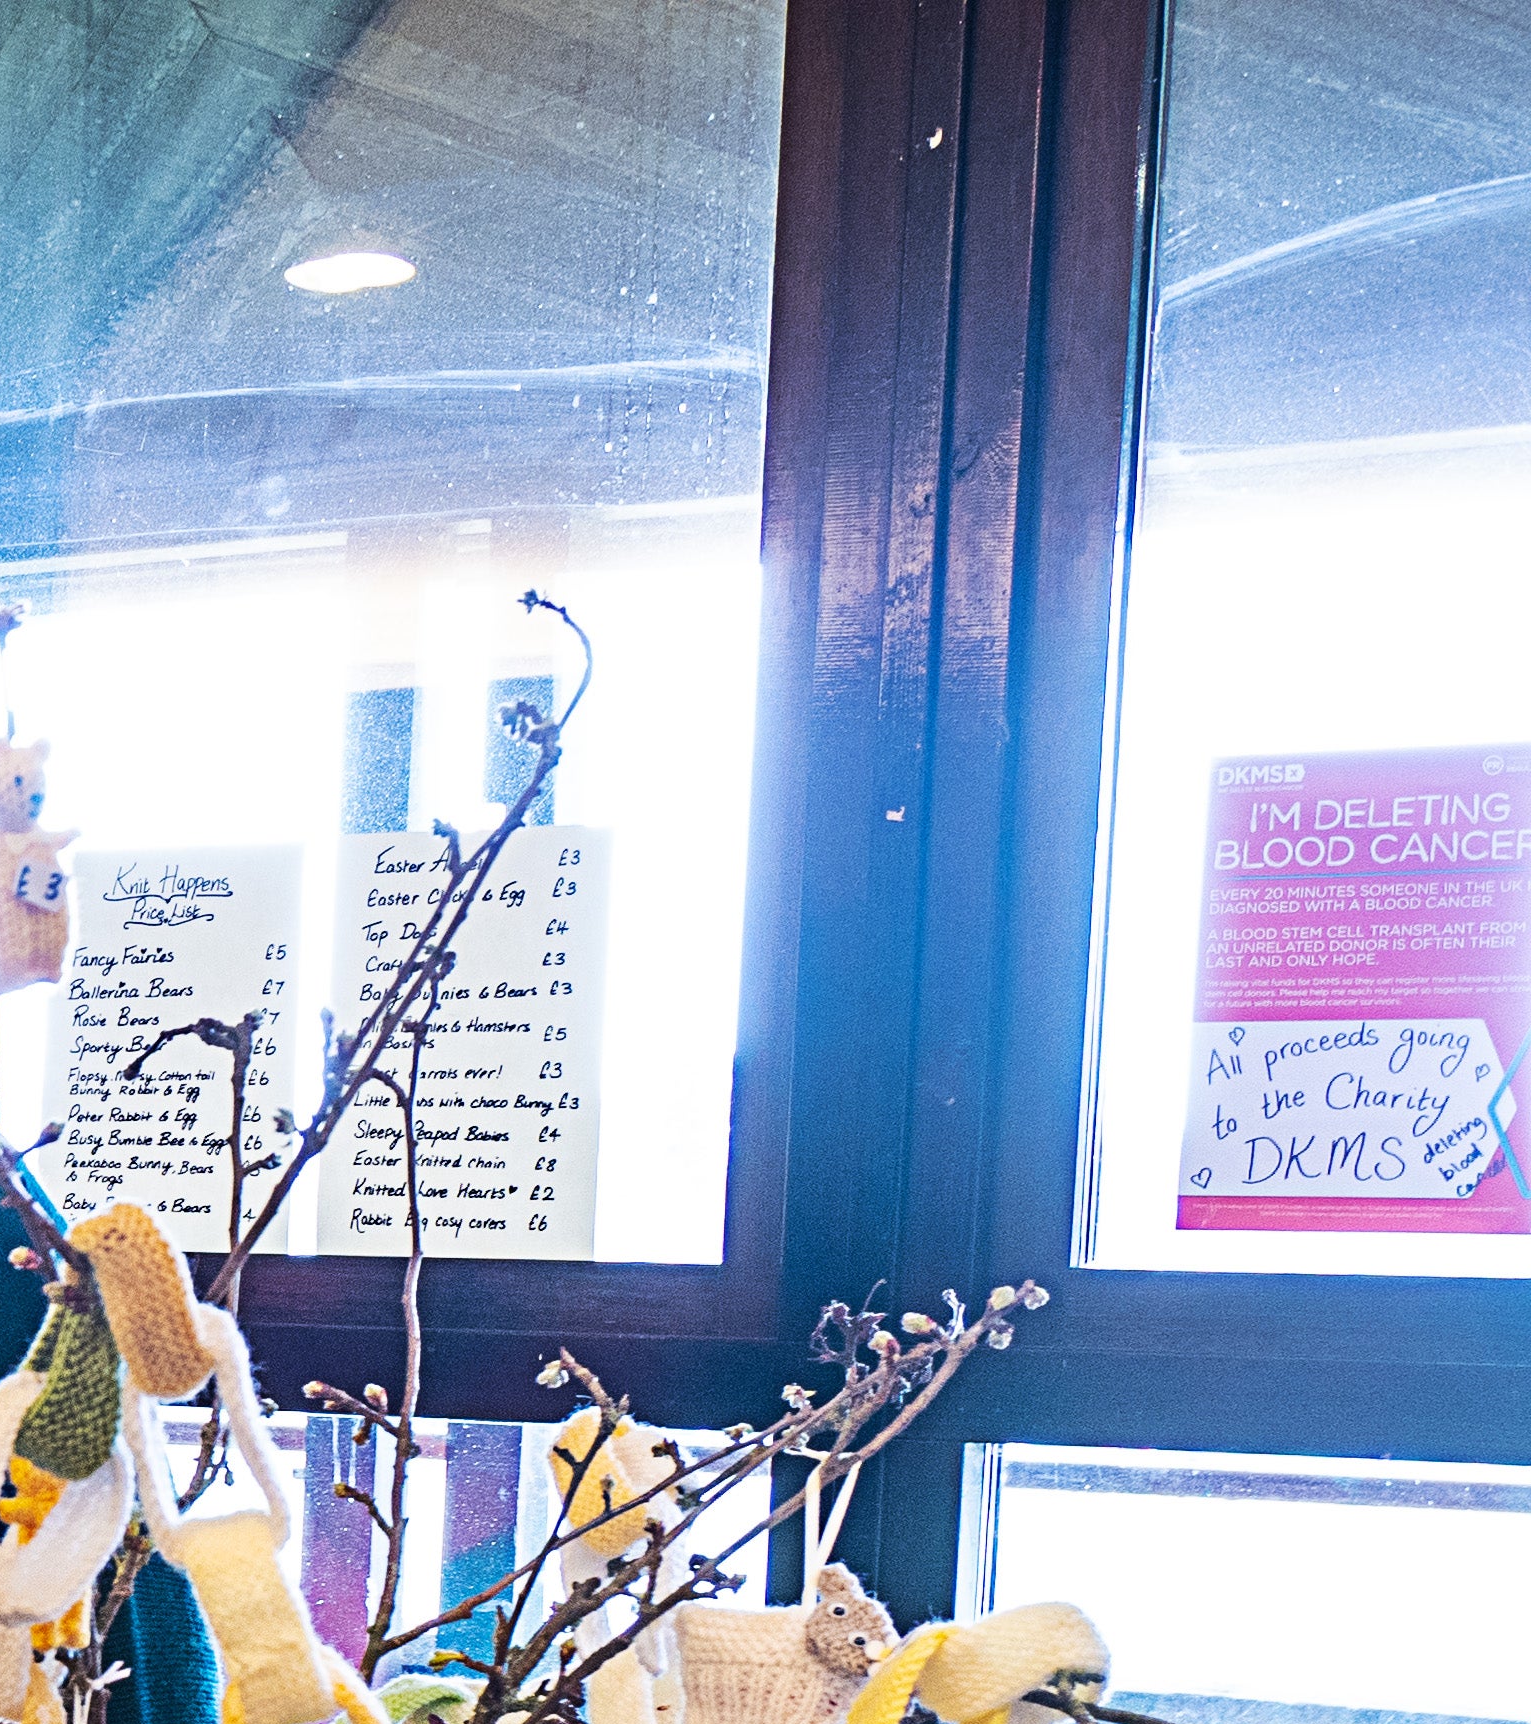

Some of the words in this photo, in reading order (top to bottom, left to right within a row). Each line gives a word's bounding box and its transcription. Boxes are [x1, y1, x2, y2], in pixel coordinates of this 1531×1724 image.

[1217, 765, 1283, 786] DKMS
[1314, 792, 1512, 830] DELETING
[375, 846, 425, 874] Easter
[558, 849, 581, 866] £3
[1214, 835, 1355, 871] BLOOD
[15, 865, 62, 900] £3
[112, 863, 152, 896] Knit
[159, 863, 230, 900] Happens
[553, 877, 577, 898] £3
[1210, 888, 1259, 902] EVERY
[1264, 887, 1283, 900] 20
[1287, 884, 1356, 899] MINUTES
[1360, 882, 1438, 898] SOMEONE
[1444, 882, 1460, 894] IN
[1464, 881, 1495, 894] THE
[1501, 880, 1523, 892] UK
[367, 890, 420, 907] Easter
[499, 881, 526, 908] Egg
[133, 899, 165, 921] Price
[171, 903, 201, 921] List
[1209, 900, 1300, 915] DIAGNOSED
[1304, 899, 1344, 912] WITH
[1348, 899, 1359, 910] A
[1366, 897, 1421, 911] BLOOD
[362, 921, 388, 948] Top
[545, 919, 569, 935] £4
[1207, 929, 1218, 941] A
[1223, 928, 1278, 941] BLOOD
[1281, 926, 1322, 939] STEM
[1327, 925, 1364, 938] CELL
[1370, 923, 1476, 937] TRANSPLANT
[1479, 921, 1526, 934] FROM
[265, 944, 287, 961] £5
[1205, 941, 1229, 954] AN
[1233, 939, 1326, 954] UNRELATED
[1329, 938, 1388, 952] DONOR
[1392, 939, 1406, 951] IS
[1410, 936, 1465, 950] OFTEN
[1470, 935, 1516, 949] THEIR
[73, 947, 118, 976] Fancy
[122, 945, 175, 965] Fairies
[542, 953, 566, 966] £3
[1205, 955, 1243, 969] LAST
[1248, 954, 1282, 967] AND
[1286, 954, 1328, 968] ONLY
[69, 978, 139, 1001] Ballerina
[145, 978, 194, 998] Bears
[262, 980, 285, 996] £7
[494, 982, 537, 999] Bears
[550, 981, 573, 996] £3
[72, 1004, 107, 1028] Rosie
[117, 1006, 160, 1027] Bears
[466, 1017, 531, 1033] Hamsters
[544, 1026, 567, 1041] £5
[70, 1036, 124, 1064] Sporty
[252, 1037, 276, 1056] £6
[1207, 1049, 1243, 1086] All
[1264, 1022, 1381, 1081] proceeds
[1388, 1029, 1471, 1078] going
[248, 1069, 269, 1086] £6
[464, 1065, 503, 1079] ever!
[540, 1061, 563, 1079] £3
[69, 1086, 111, 1101] Bunny
[177, 1086, 201, 1103] Egg
[354, 1092, 391, 1107] Little
[513, 1094, 554, 1116] Bunny
[558, 1093, 580, 1110] £3
[68, 1104, 104, 1123] Peter
[109, 1107, 154, 1122] Rabbit
[174, 1108, 198, 1129] Egg
[242, 1106, 262, 1122] £6
[1211, 1105, 1237, 1140] to
[1262, 1090, 1306, 1119] the
[1325, 1073, 1450, 1137] Charity
[68, 1129, 104, 1154] Busy
[157, 1132, 185, 1146] Bee
[354, 1120, 404, 1150] Sleepy
[538, 1126, 561, 1142] £4
[1423, 1116, 1488, 1165] deleting
[243, 1140, 263, 1151] £6
[179, 1160, 214, 1174] Bears
[353, 1150, 402, 1167] Easter
[534, 1158, 557, 1173] £8
[1242, 1131, 1405, 1184] DKMS
[1438, 1143, 1484, 1182] blood
[88, 1171, 123, 1191] Frogs
[353, 1178, 407, 1198] Knitted
[417, 1181, 448, 1199] Love
[457, 1182, 506, 1200] Hearts
[530, 1186, 555, 1201] £2
[172, 1198, 212, 1214] Bears
[350, 1208, 393, 1233] Rabbit
[435, 1216, 462, 1238] cosy
[468, 1218, 507, 1230] covers
[529, 1213, 548, 1231] £6
